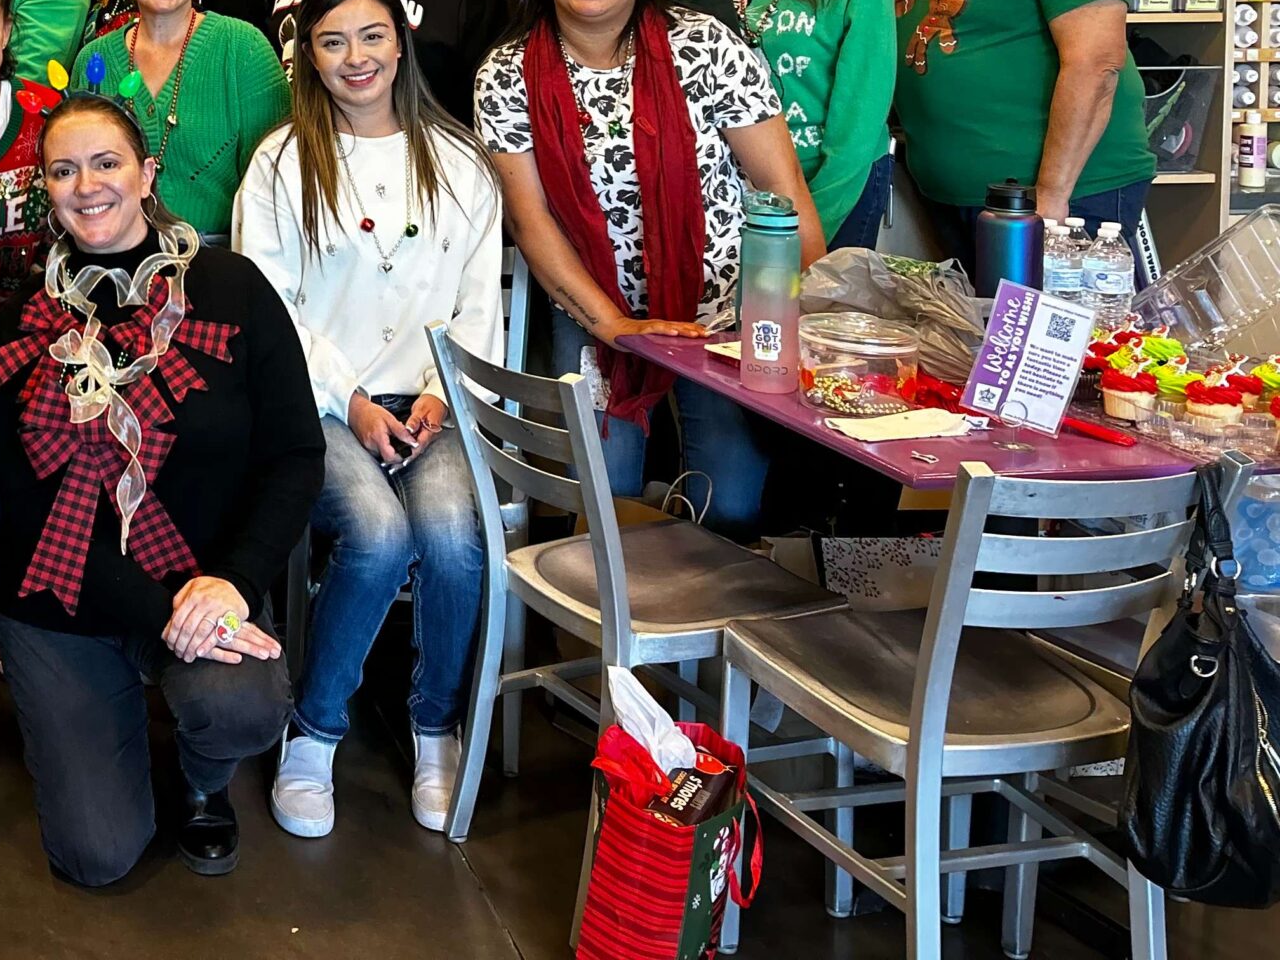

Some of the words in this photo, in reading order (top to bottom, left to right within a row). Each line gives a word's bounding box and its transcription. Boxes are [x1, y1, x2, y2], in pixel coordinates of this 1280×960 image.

[756, 9, 816, 36] SON
[777, 52, 811, 77] OF
[785, 101, 808, 122] A
[1138, 223, 1151, 249] BOOK
[1146, 255, 1158, 281] ONAL
[1019, 292, 1036, 328] WISH!
[755, 325, 779, 334] YOU
[755, 334, 779, 343] GOT
[982, 296, 1021, 374] Welcome
[1011, 327, 1025, 353] YOU
[755, 342, 779, 351] THIS
[1005, 353, 1018, 369] AS
[998, 370, 1011, 385] TO
